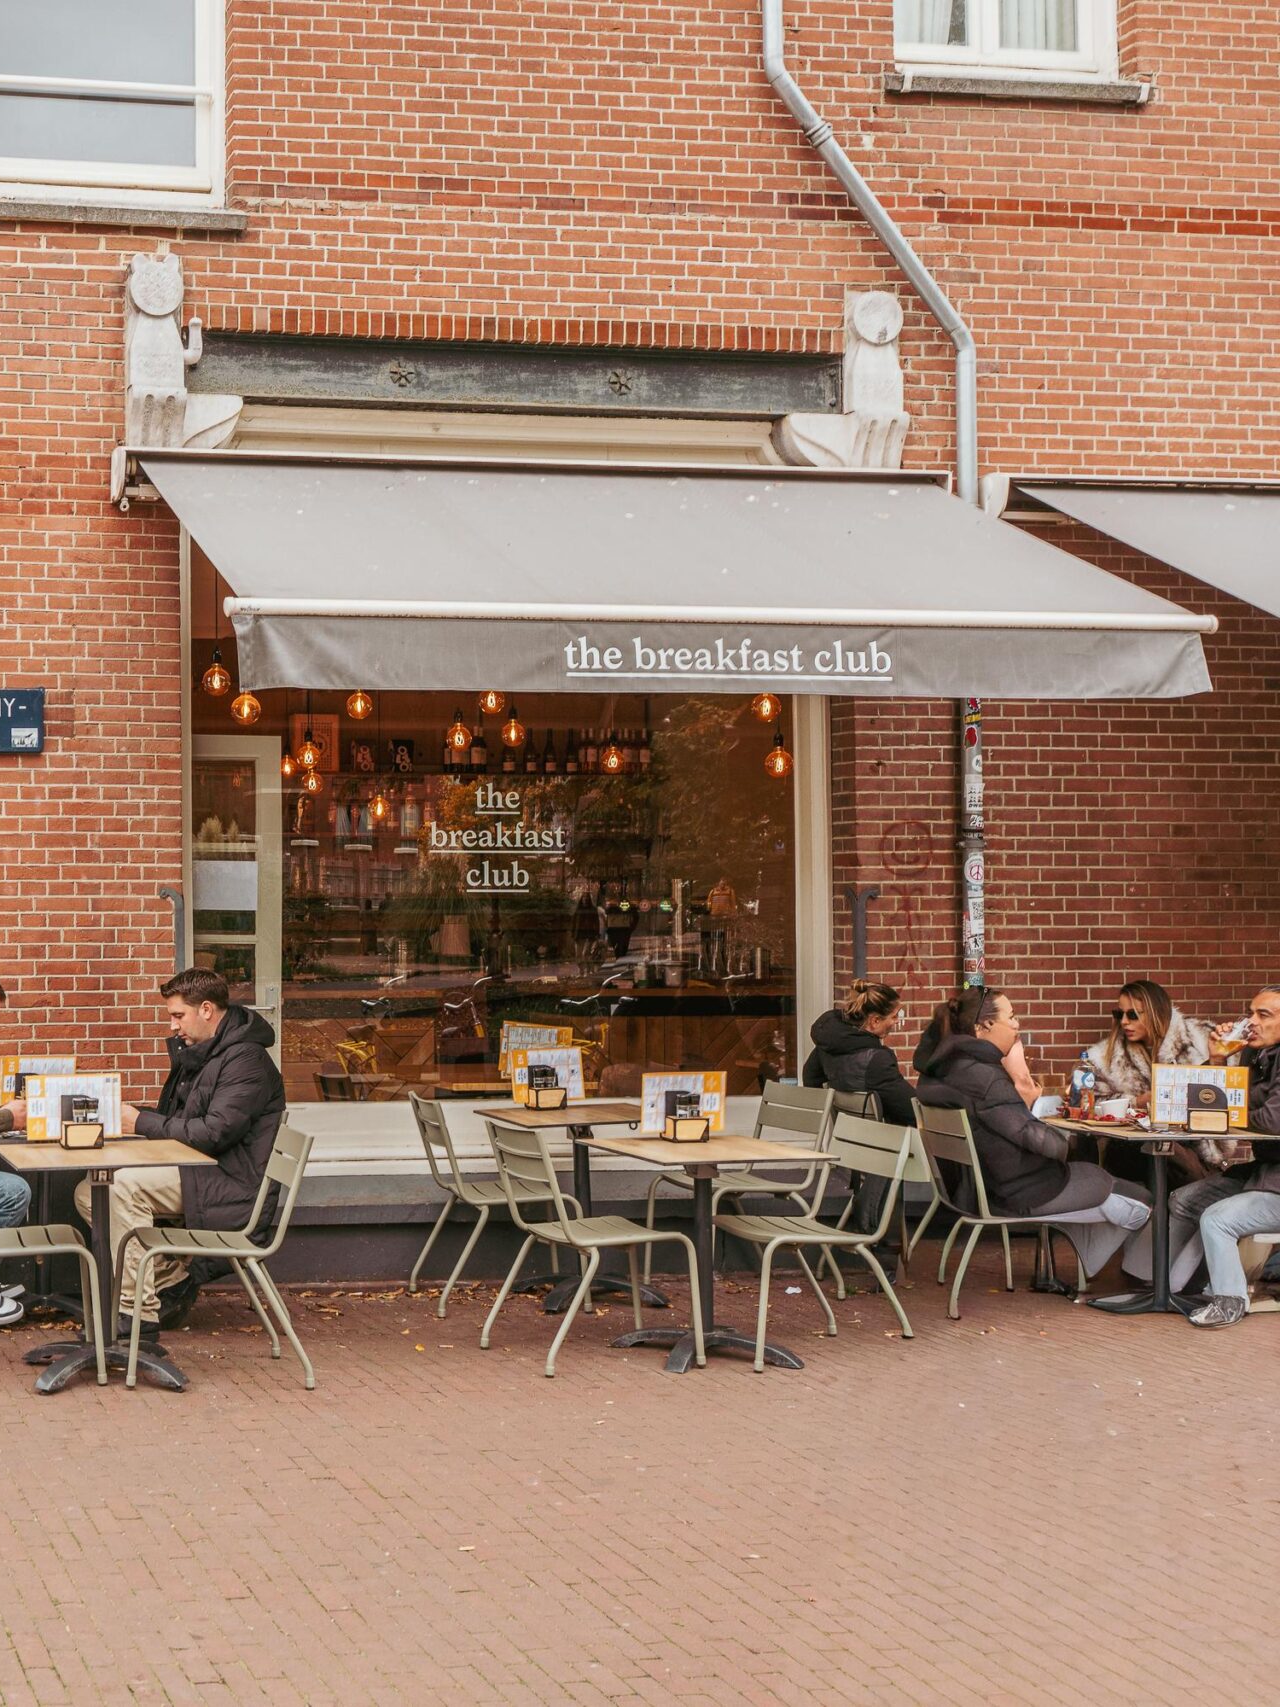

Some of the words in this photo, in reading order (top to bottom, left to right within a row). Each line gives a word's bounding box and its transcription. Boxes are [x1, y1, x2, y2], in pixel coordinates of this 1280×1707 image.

[564, 636, 623, 671] the
[633, 637, 804, 673] breakfast
[814, 640, 893, 674] club
[475, 782, 521, 810] the
[430, 821, 566, 849] breakfast
[466, 861, 530, 888] club
